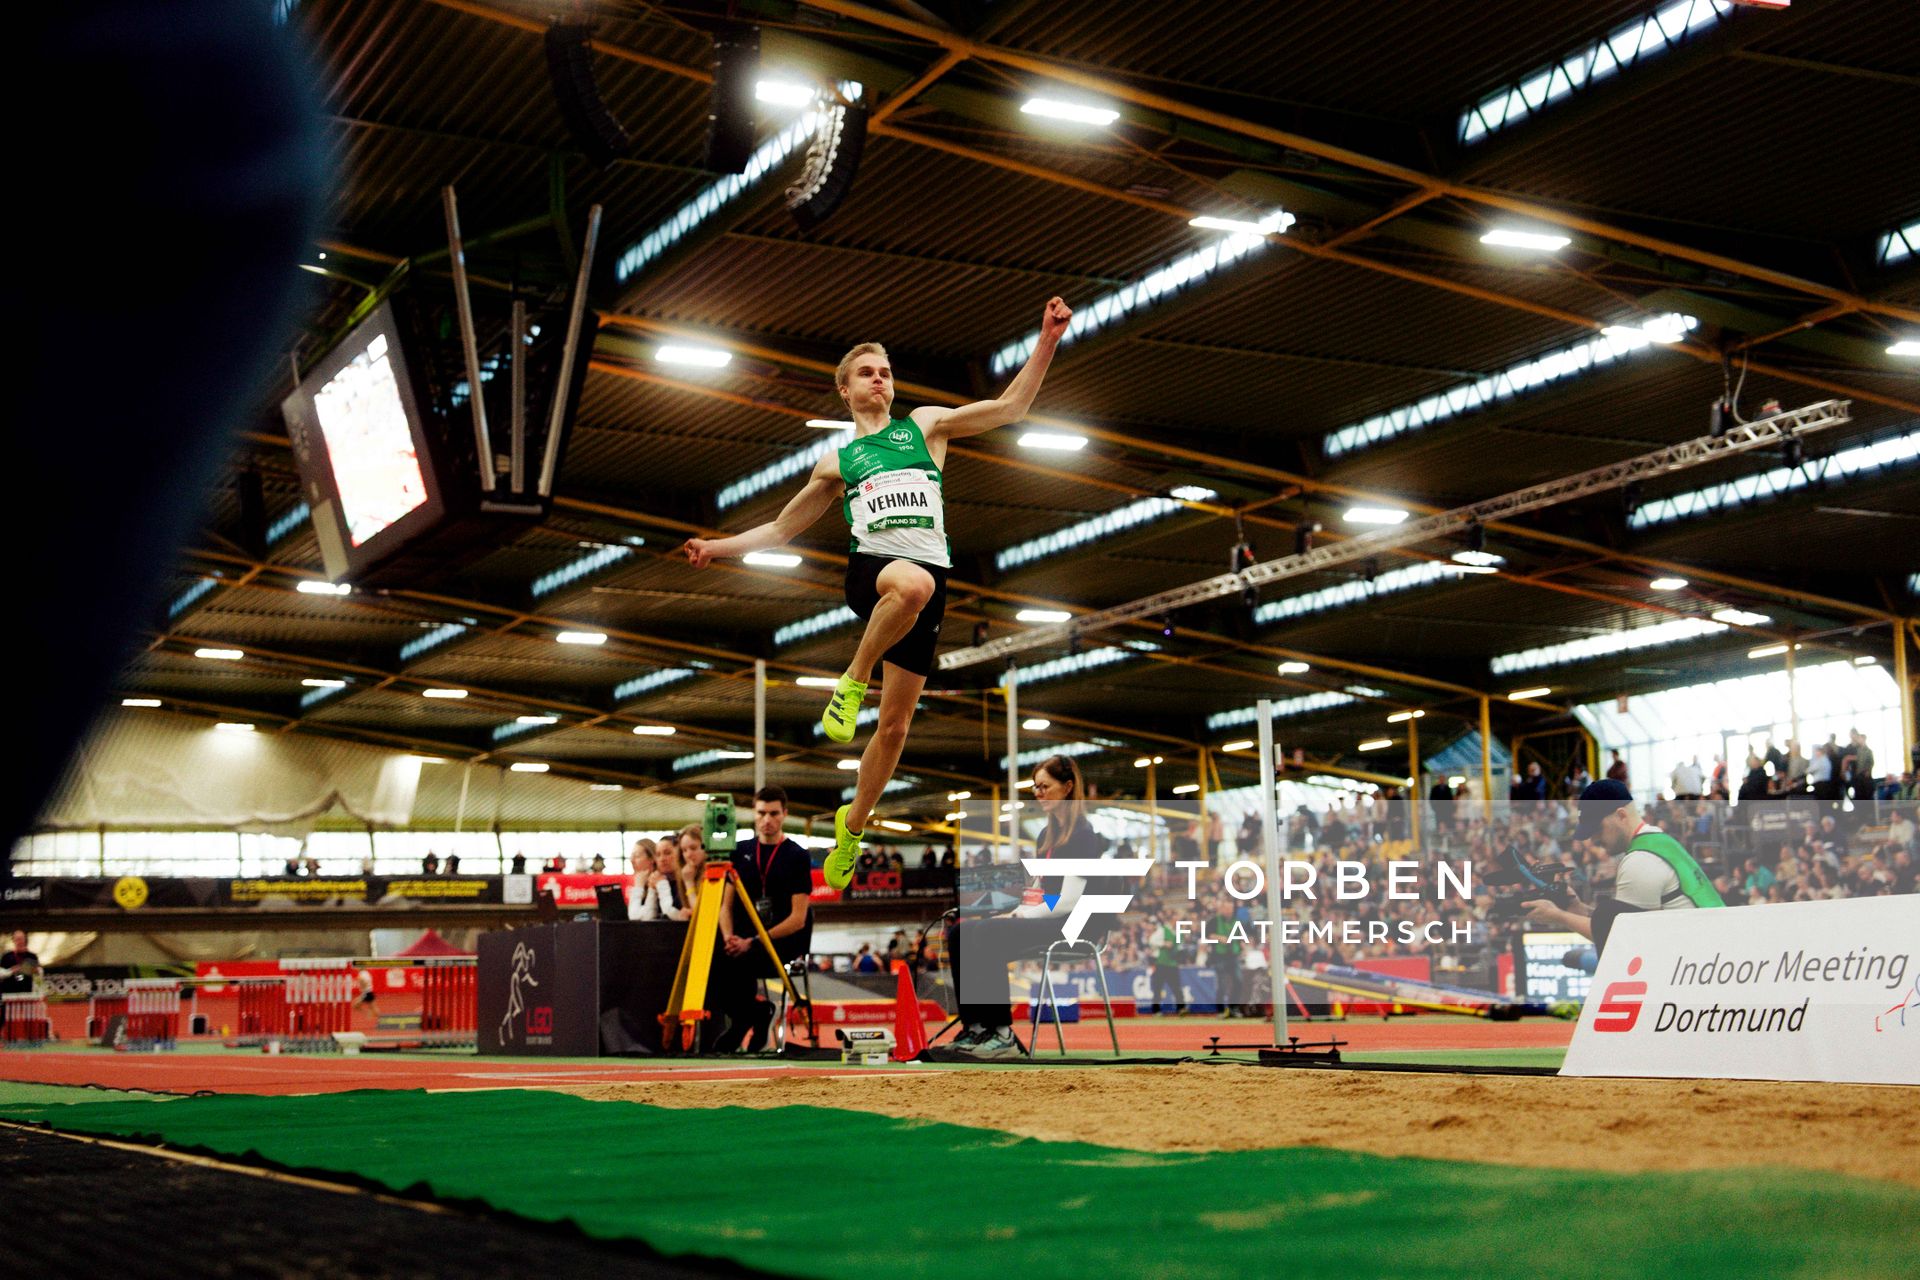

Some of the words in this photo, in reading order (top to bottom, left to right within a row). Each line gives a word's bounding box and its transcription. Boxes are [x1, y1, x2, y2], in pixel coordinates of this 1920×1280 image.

[866, 491, 928, 514] VEHMAA
[1670, 952, 1770, 986] Indoor
[1773, 946, 1910, 990] Meeting
[1654, 997, 1810, 1033] Dortmund
